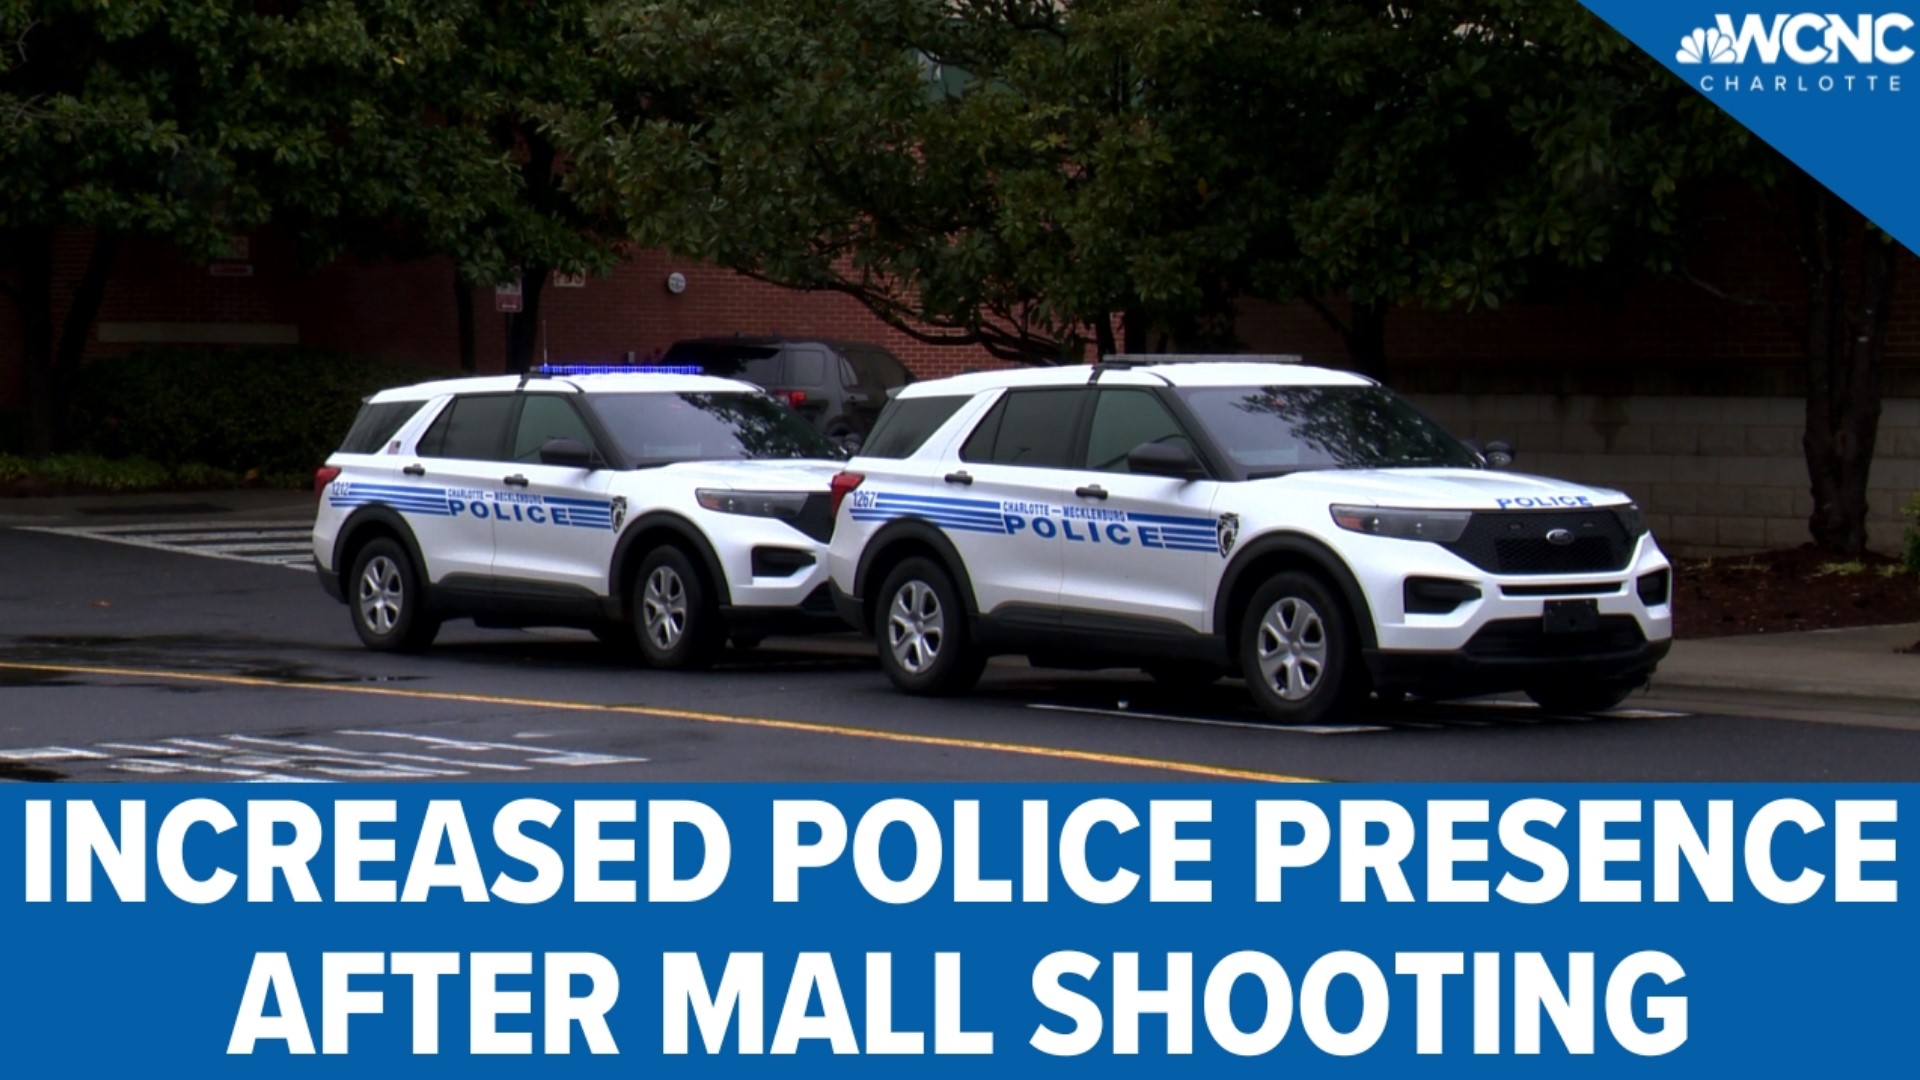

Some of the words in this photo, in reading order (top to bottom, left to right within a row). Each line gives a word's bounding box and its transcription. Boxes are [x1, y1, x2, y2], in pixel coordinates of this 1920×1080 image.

[447, 489, 484, 501] CHARLOTTE
[851, 491, 877, 509] 1267
[1496, 496, 1594, 510] POLICE
[448, 500, 570, 526] POLICE
[1002, 501, 1050, 516] CHARLOTTE
[1063, 506, 1126, 522] MECKLENBURG
[1004, 515, 1164, 549] POLICE
